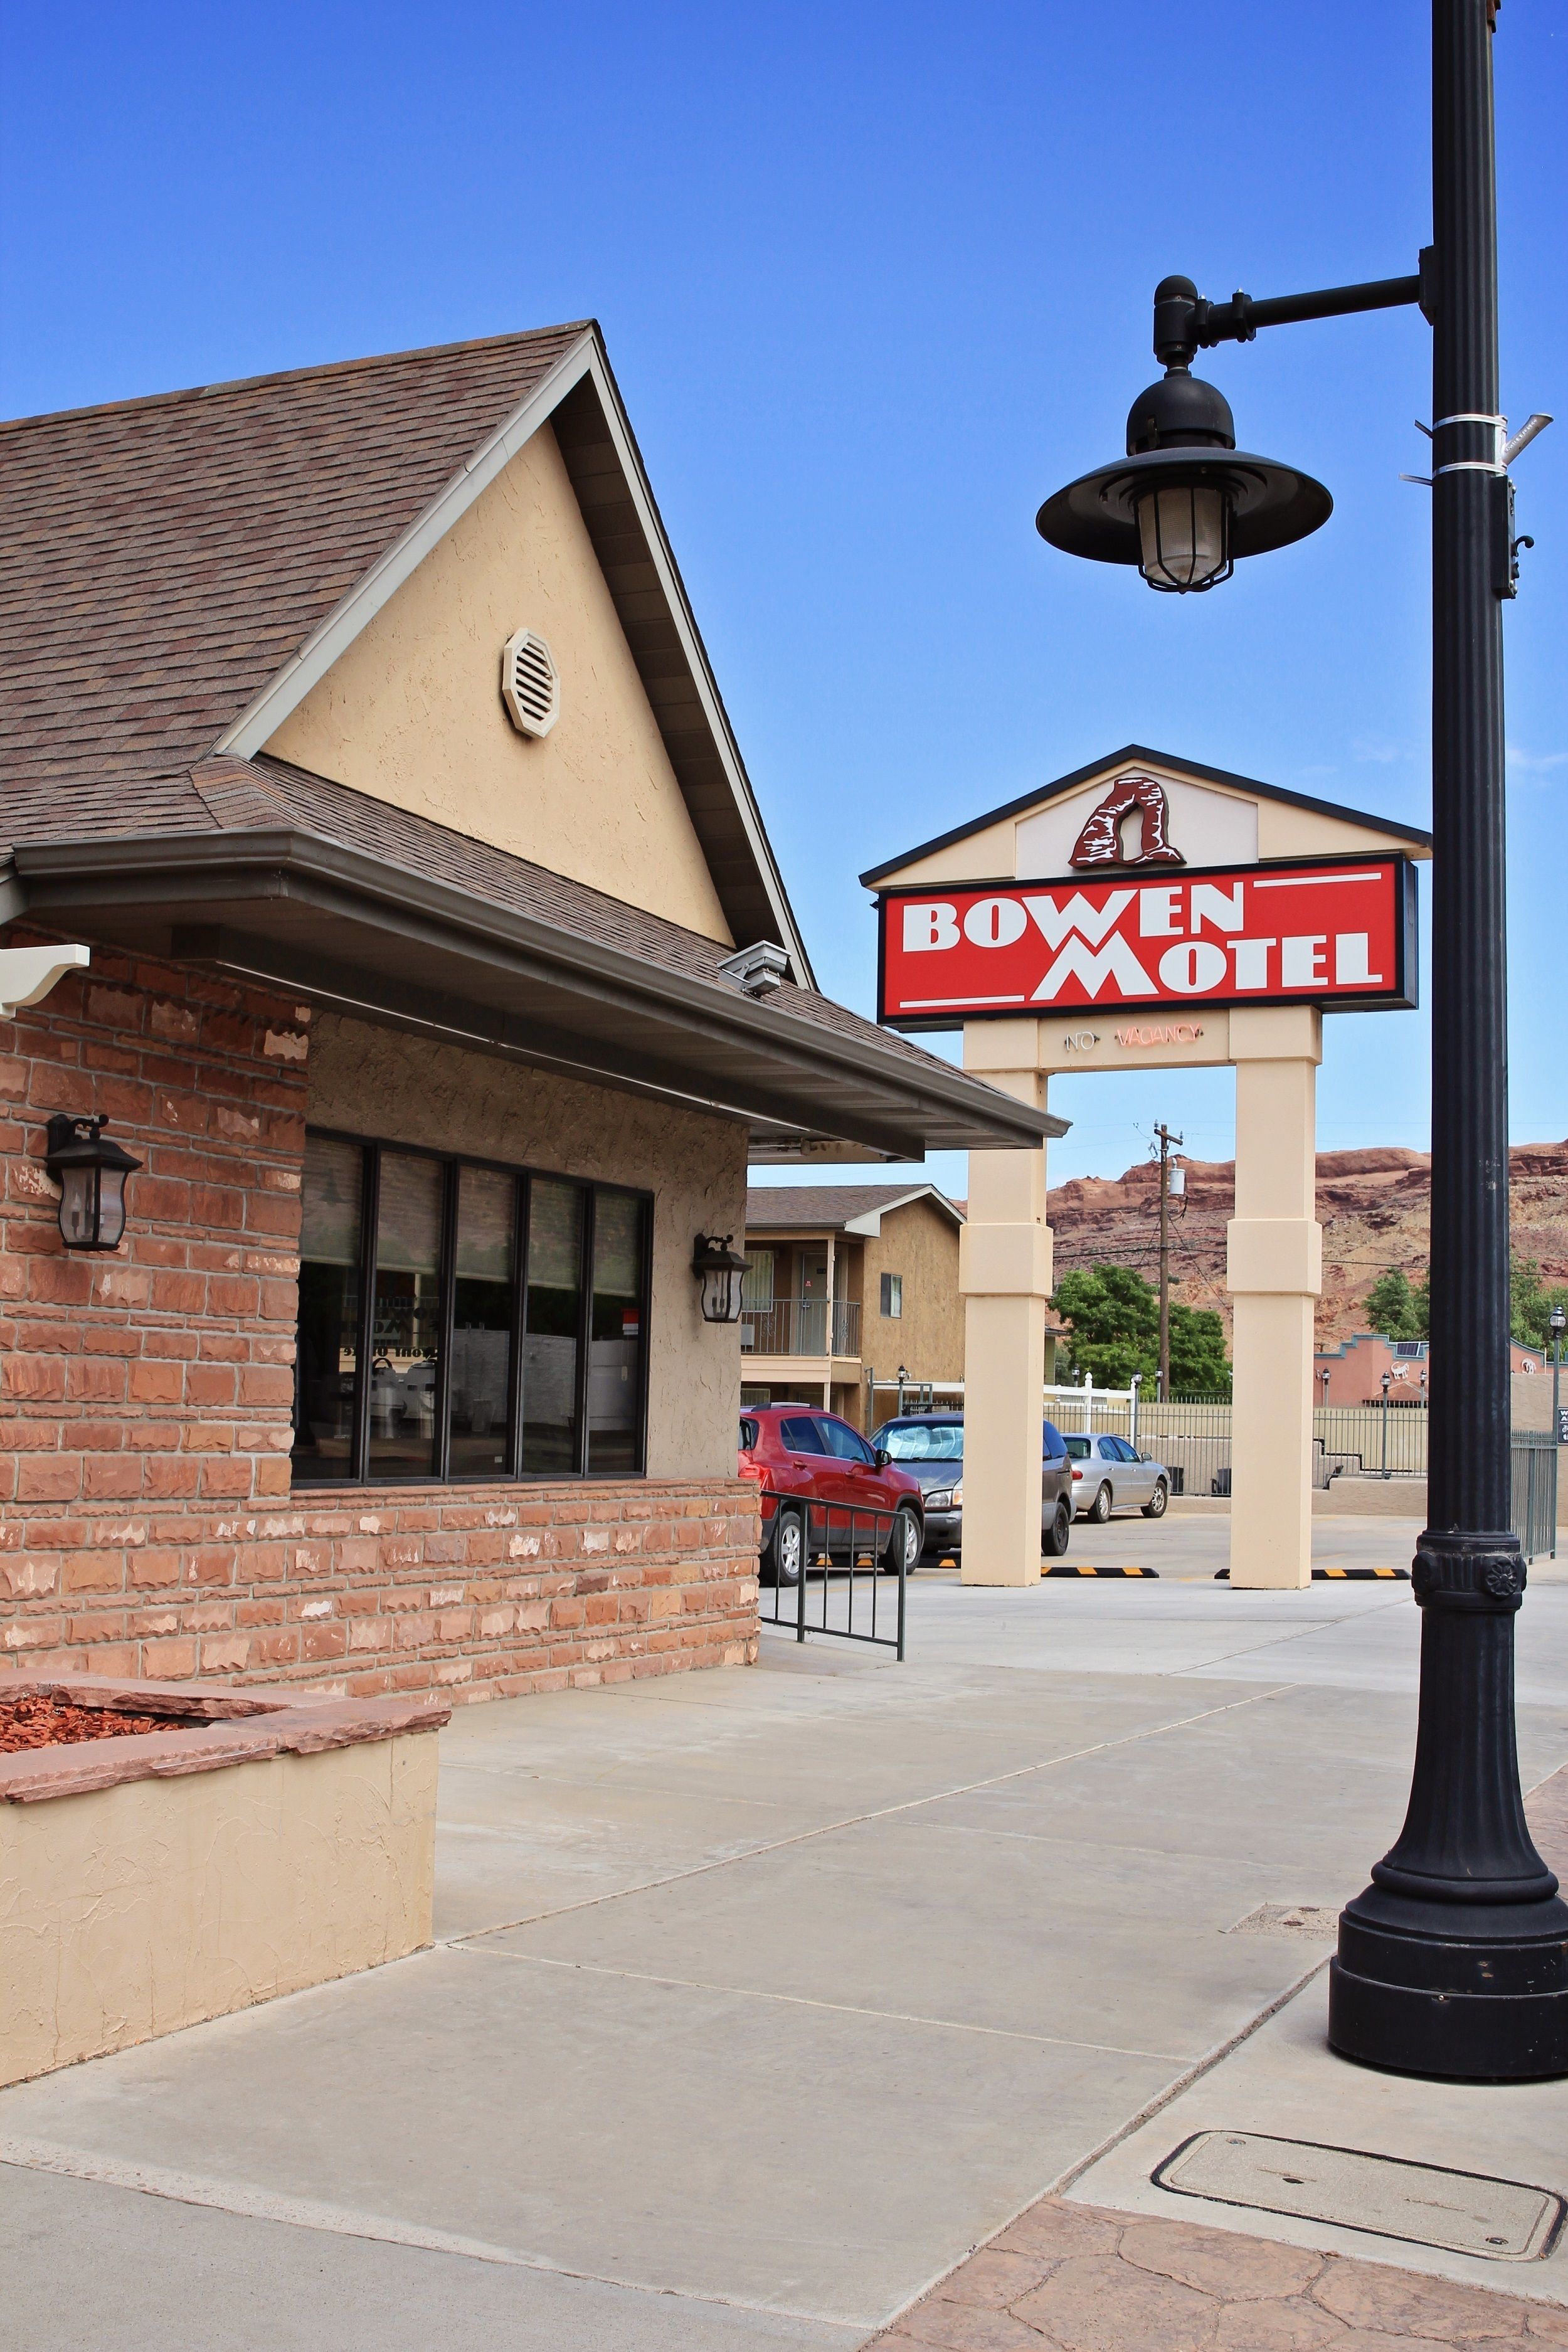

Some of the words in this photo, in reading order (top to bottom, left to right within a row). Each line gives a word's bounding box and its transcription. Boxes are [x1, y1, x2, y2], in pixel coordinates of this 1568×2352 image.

[903, 882, 1244, 952] BOWEN
[1030, 931, 1383, 1000] MOTEL
[1066, 1031, 1096, 1051] NO
[1116, 1024, 1202, 1047] VACANCY
